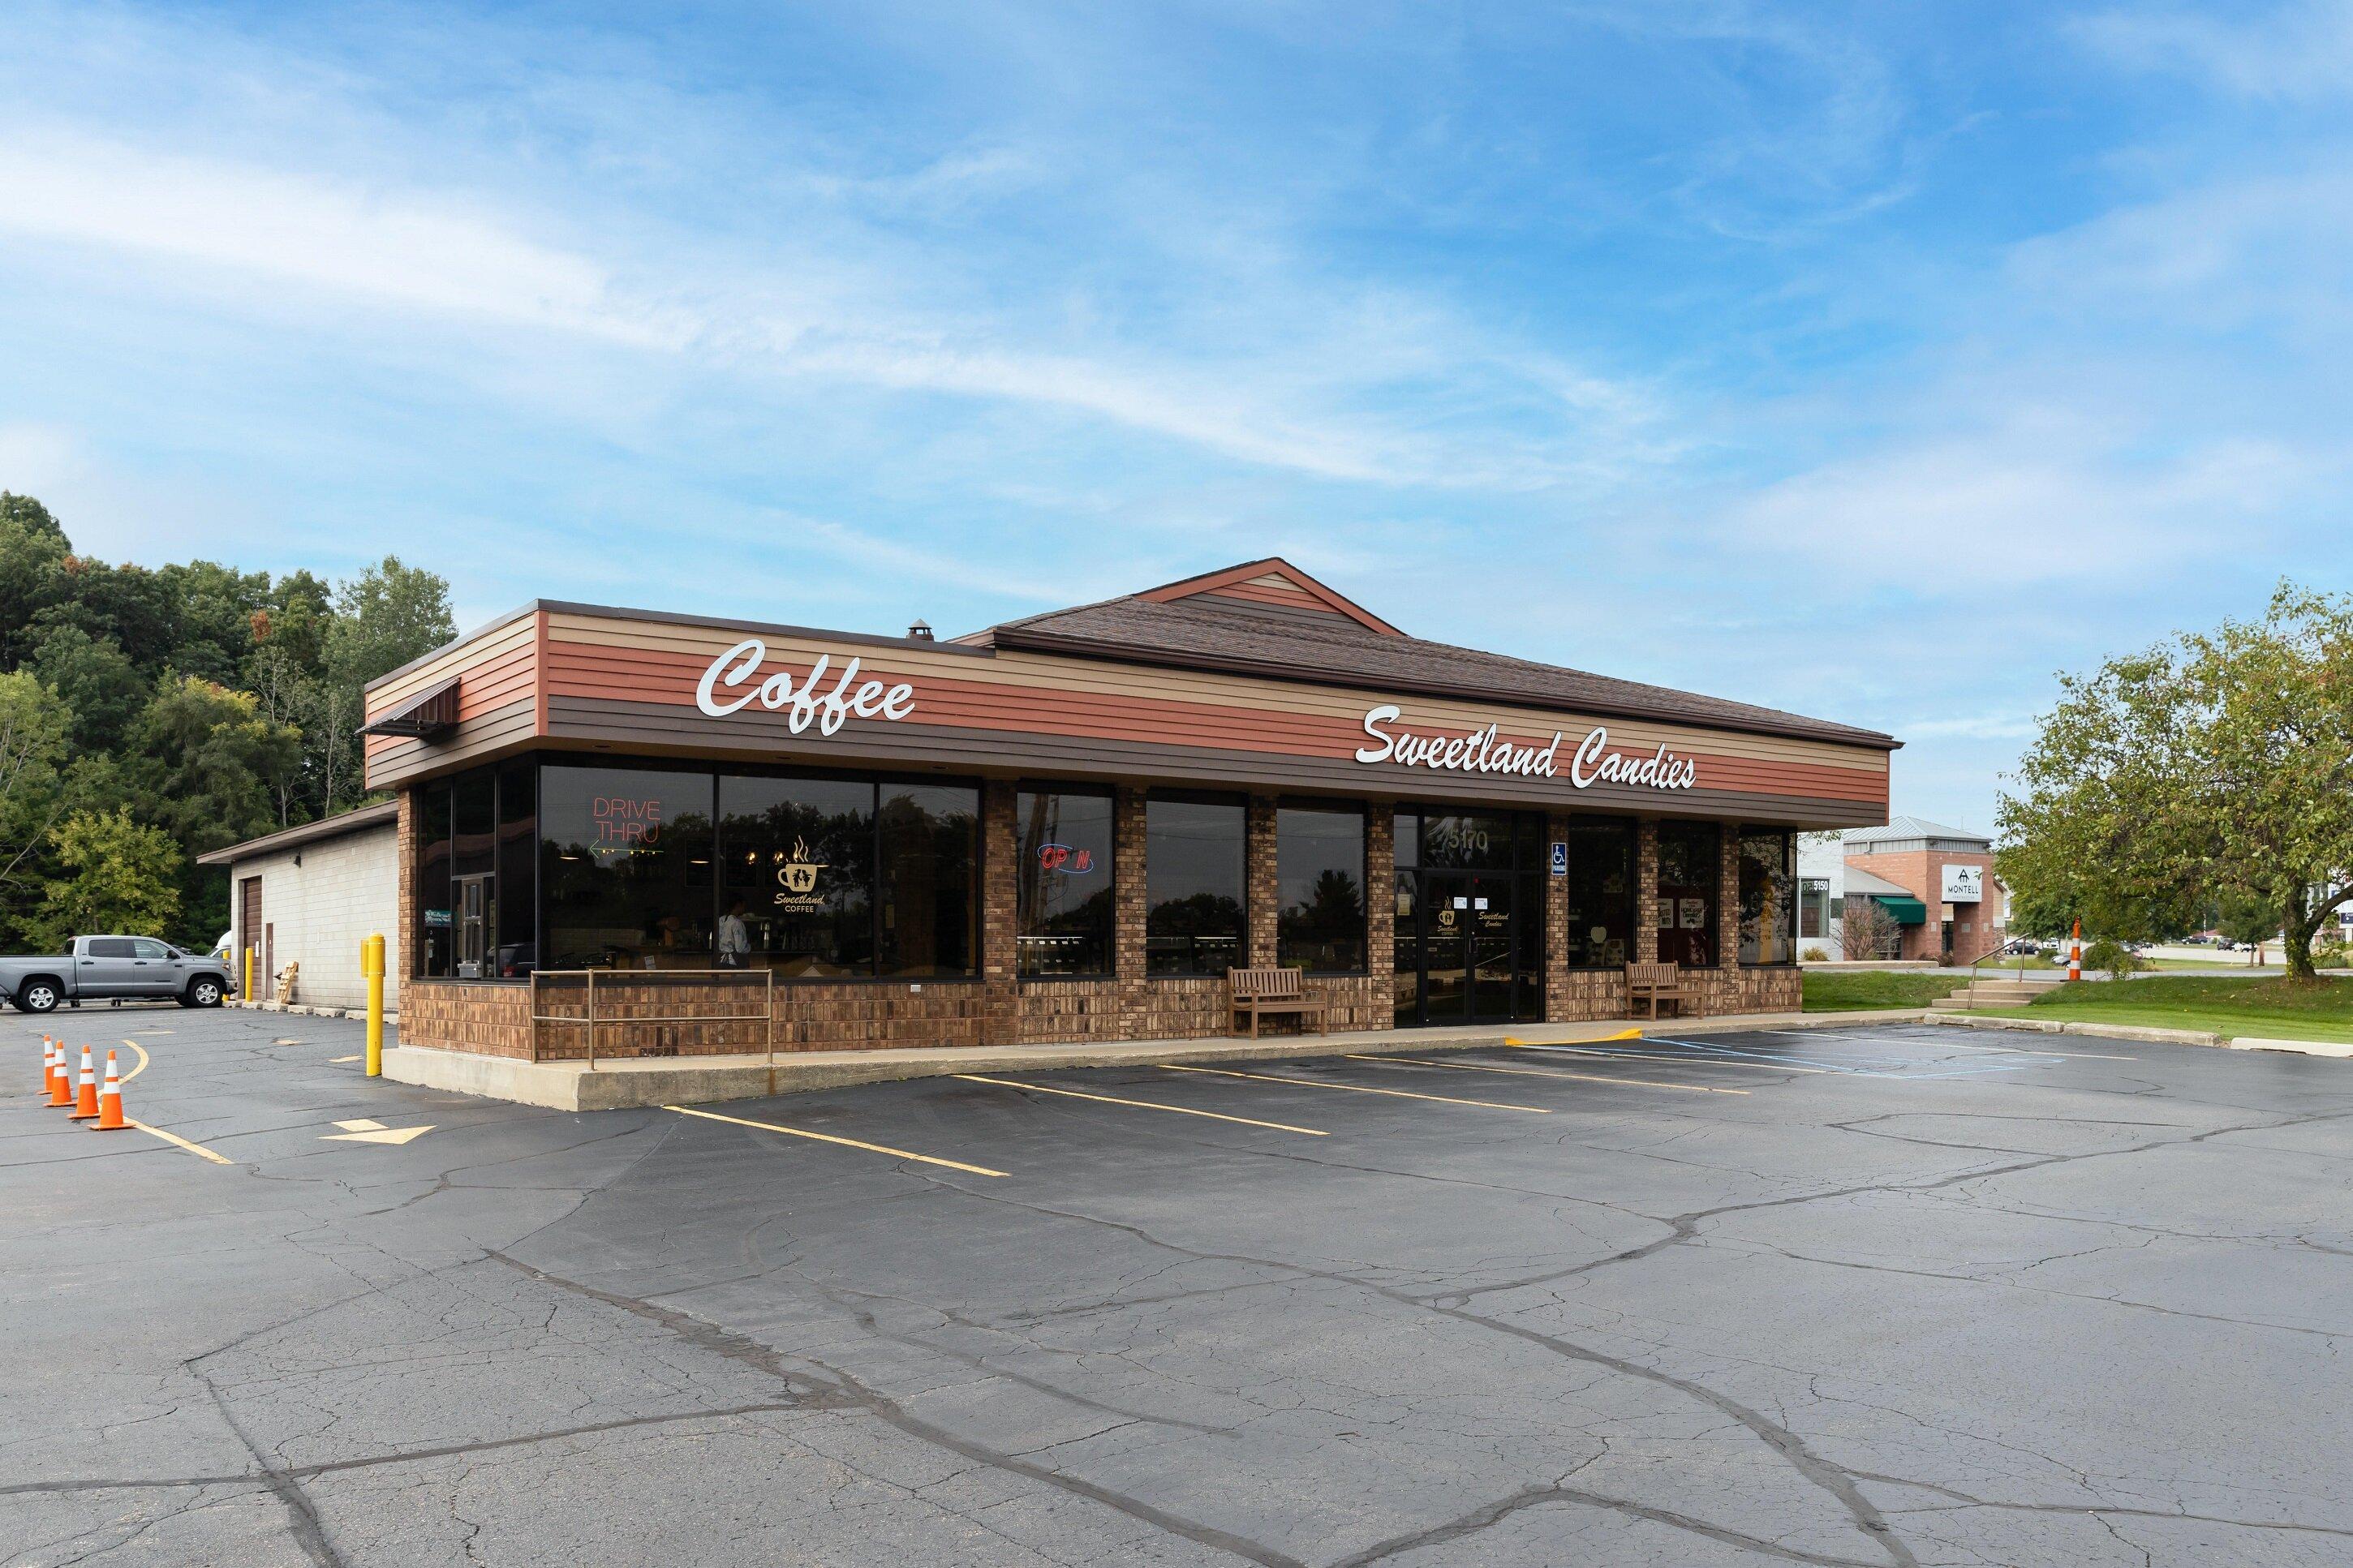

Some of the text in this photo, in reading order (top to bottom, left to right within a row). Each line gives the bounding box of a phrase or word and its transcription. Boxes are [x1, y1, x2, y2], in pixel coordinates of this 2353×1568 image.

[696, 639, 915, 737] Coffee
[1355, 705, 1697, 789] Sweetland Candies
[593, 797, 660, 820] DRIVE
[595, 821, 659, 843] THRU
[1448, 830, 1488, 850] 5170
[1042, 848, 1090, 870] OPN
[1813, 880, 1829, 891] 5150
[1947, 885, 1979, 894] MONTELL
[773, 892, 825, 904] Sweetland
[1478, 911, 1510, 921] Sweetland
